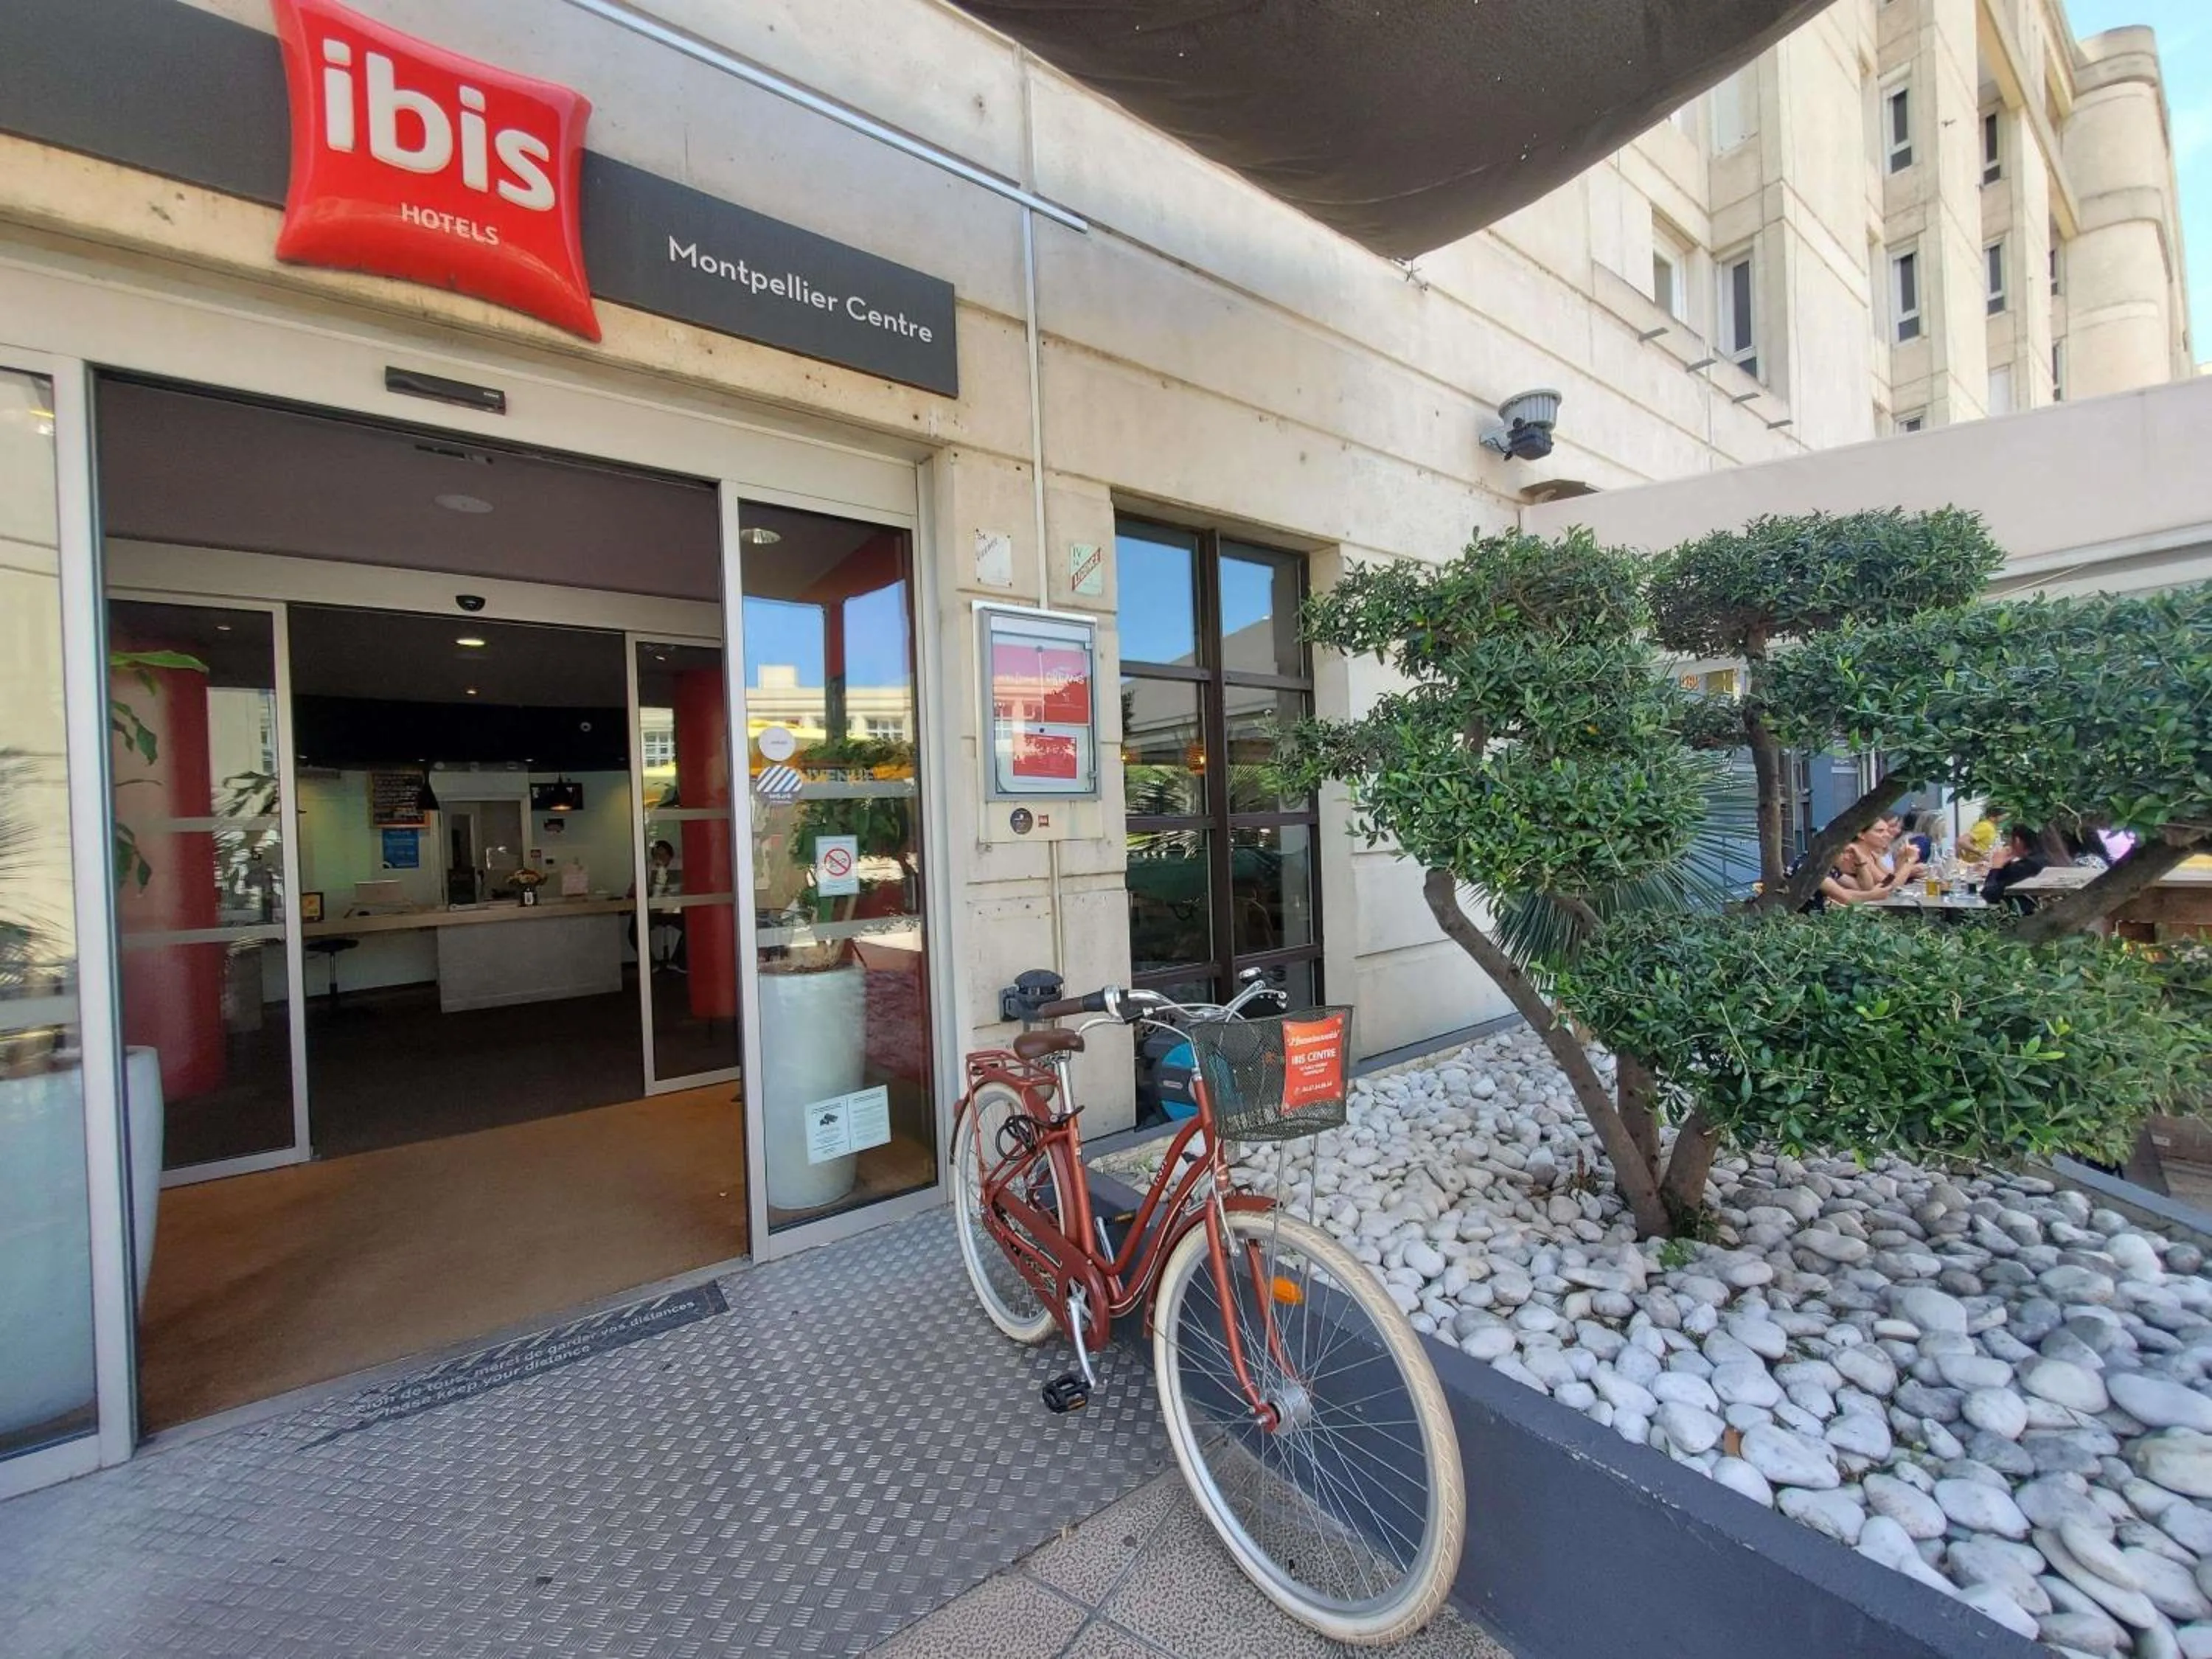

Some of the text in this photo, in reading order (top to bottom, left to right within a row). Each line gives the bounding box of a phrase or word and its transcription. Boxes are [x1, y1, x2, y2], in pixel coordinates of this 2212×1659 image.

[323, 38, 554, 212] ibis
[401, 202, 500, 246] HOTELS
[669, 235, 933, 343] Montpellier Centre
[1307, 1048, 1336, 1062] CENTRE
[524, 1349, 543, 1362] de
[548, 1332, 596, 1354] garder
[600, 1324, 626, 1336] vos
[630, 1301, 695, 1327] distances
[437, 1380, 477, 1399] keep
[483, 1367, 521, 1386] your
[524, 1344, 591, 1371] distance
